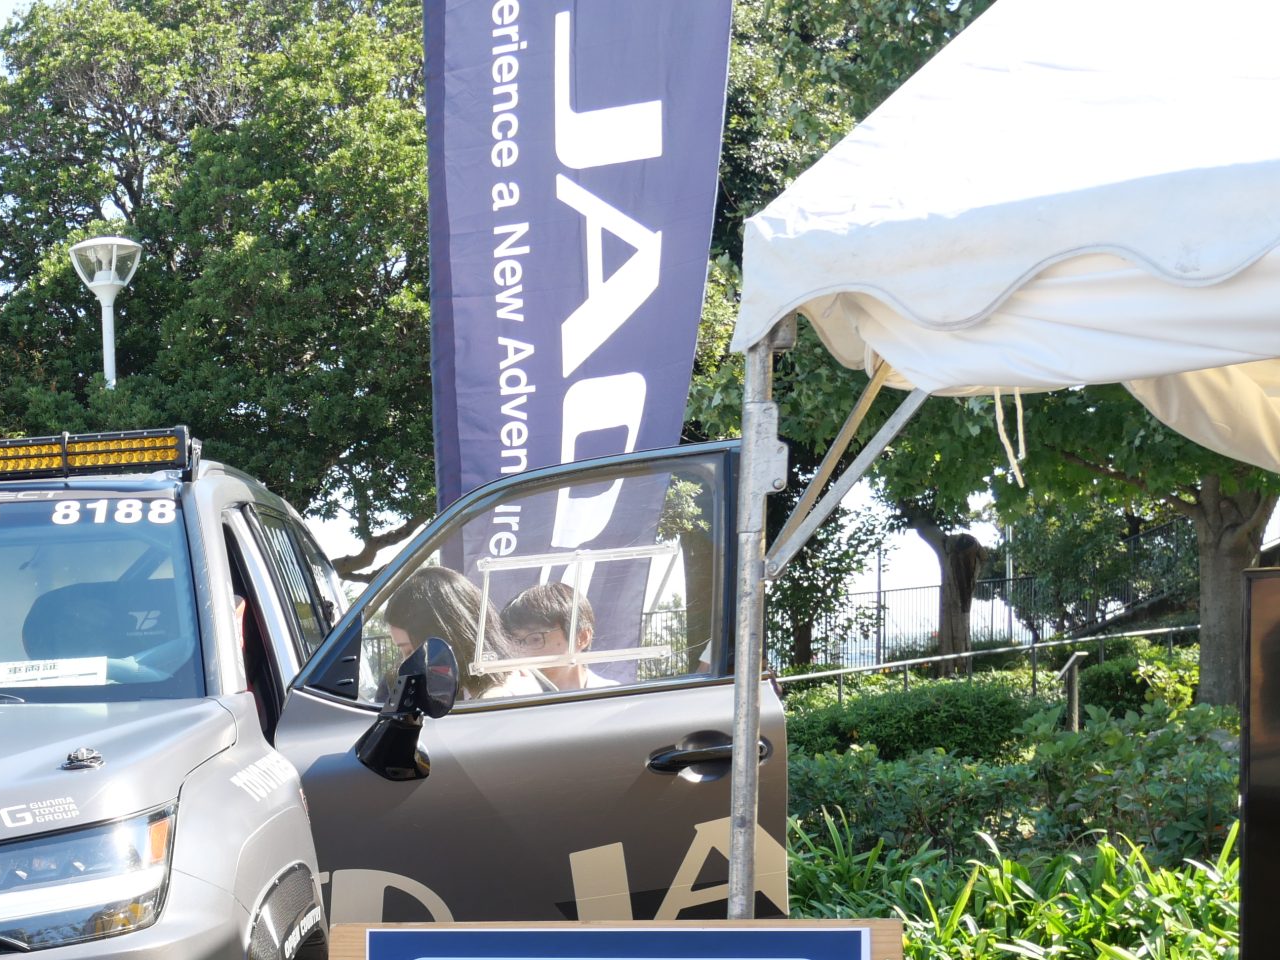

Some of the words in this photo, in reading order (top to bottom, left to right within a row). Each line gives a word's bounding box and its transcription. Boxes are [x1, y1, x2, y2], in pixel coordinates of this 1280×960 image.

[492, 182, 520, 211] a
[493, 222, 531, 322] New
[540, 10, 663, 592] JAO
[489, 337, 536, 557] Advenure
[51, 499, 177, 525] 8188
[32, 803, 78, 815] TOYOTA
[36, 810, 80, 823] GROUP
